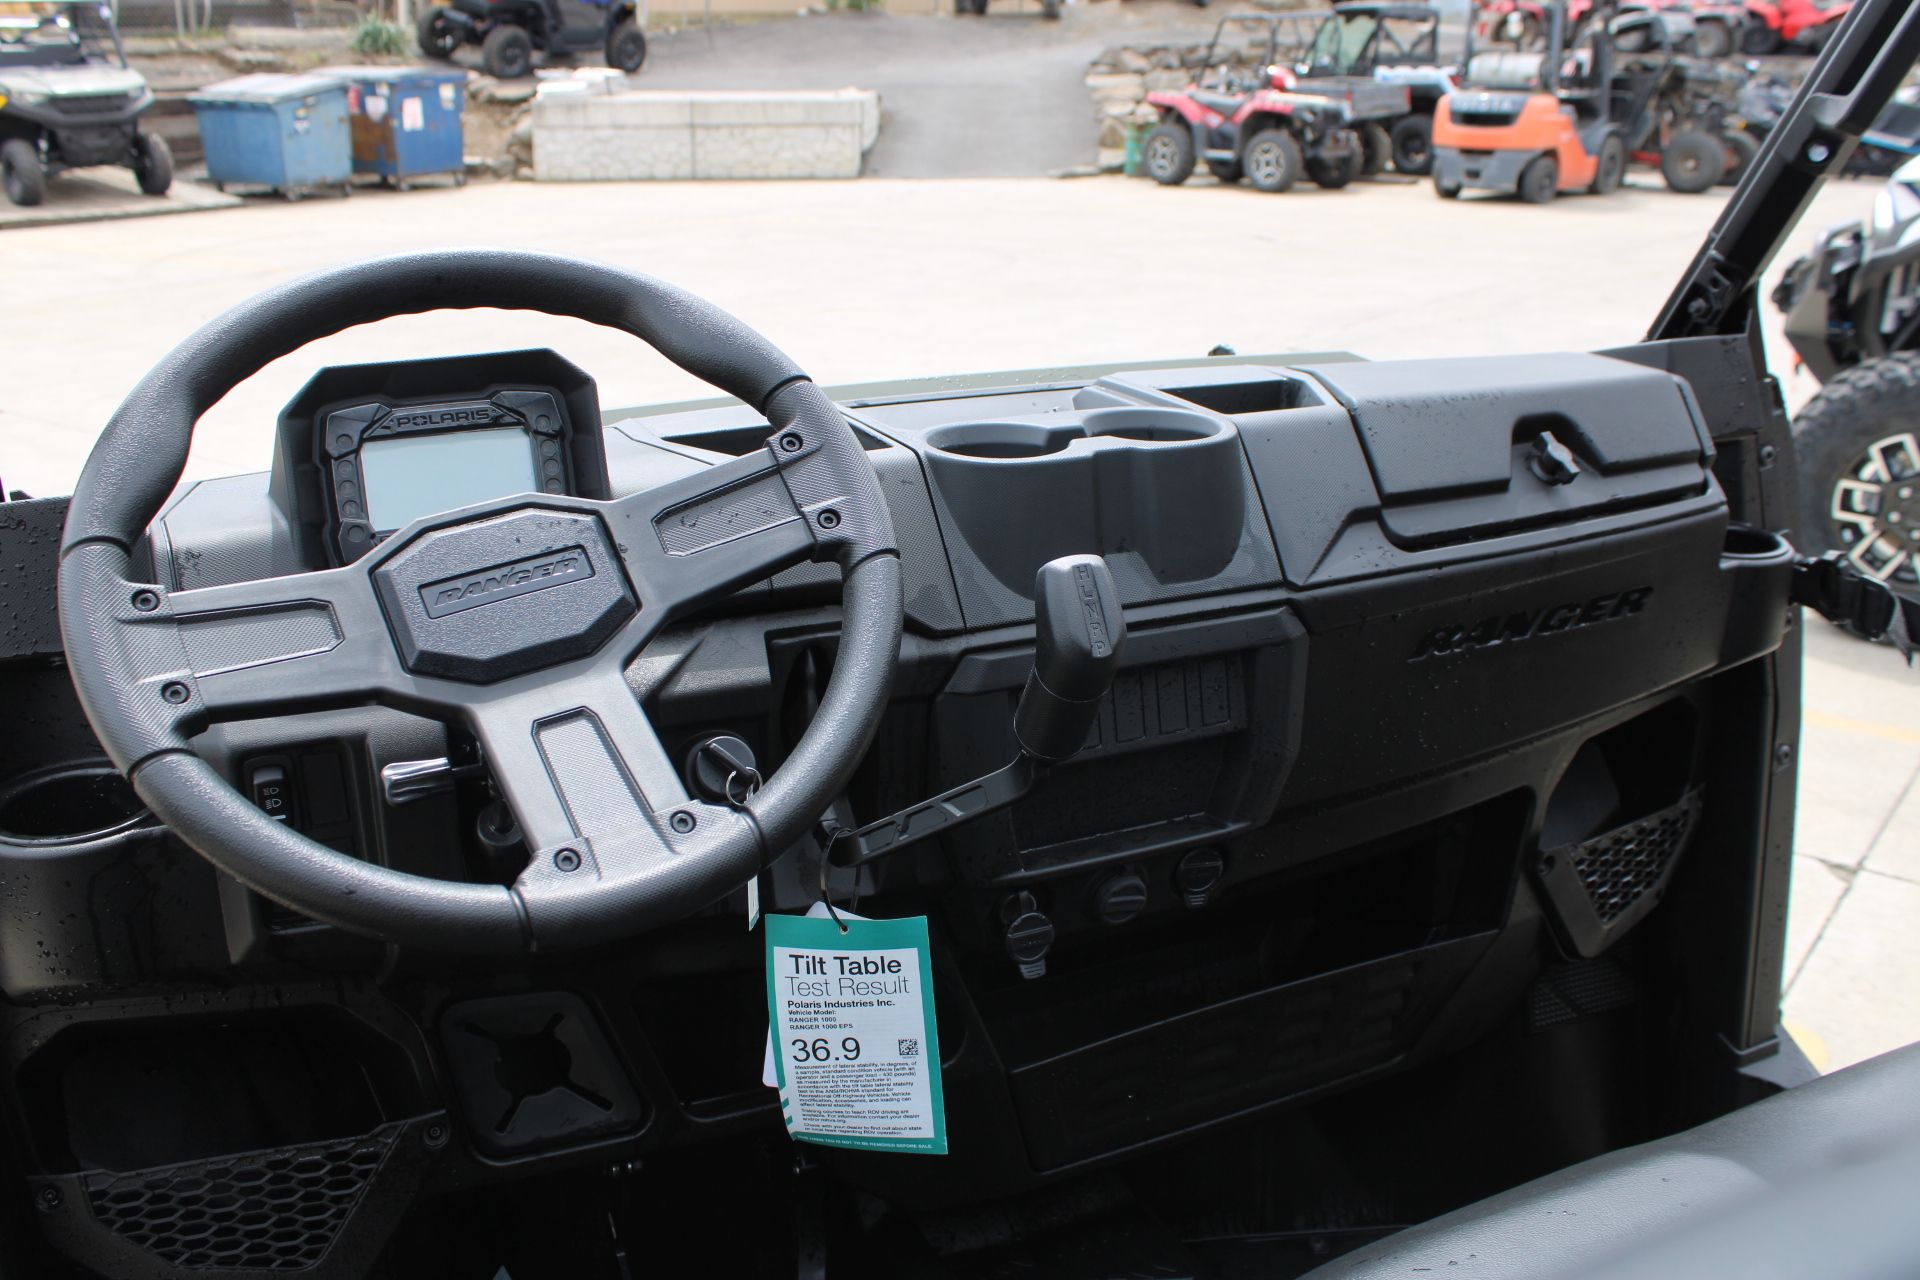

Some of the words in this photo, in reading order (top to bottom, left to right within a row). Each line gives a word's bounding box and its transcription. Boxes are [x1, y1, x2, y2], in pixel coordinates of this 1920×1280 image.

[396, 408, 491, 429] POLARIS
[434, 557, 579, 607] RANGER
[1407, 586, 1653, 662] RANGER
[789, 954, 827, 975] Tilt
[833, 955, 902, 976] Table
[785, 976, 831, 997] Test
[839, 976, 910, 997] Result
[788, 1000, 822, 1009] Polaris
[824, 1000, 874, 1008] Industries
[791, 1037, 860, 1062] 36.9
